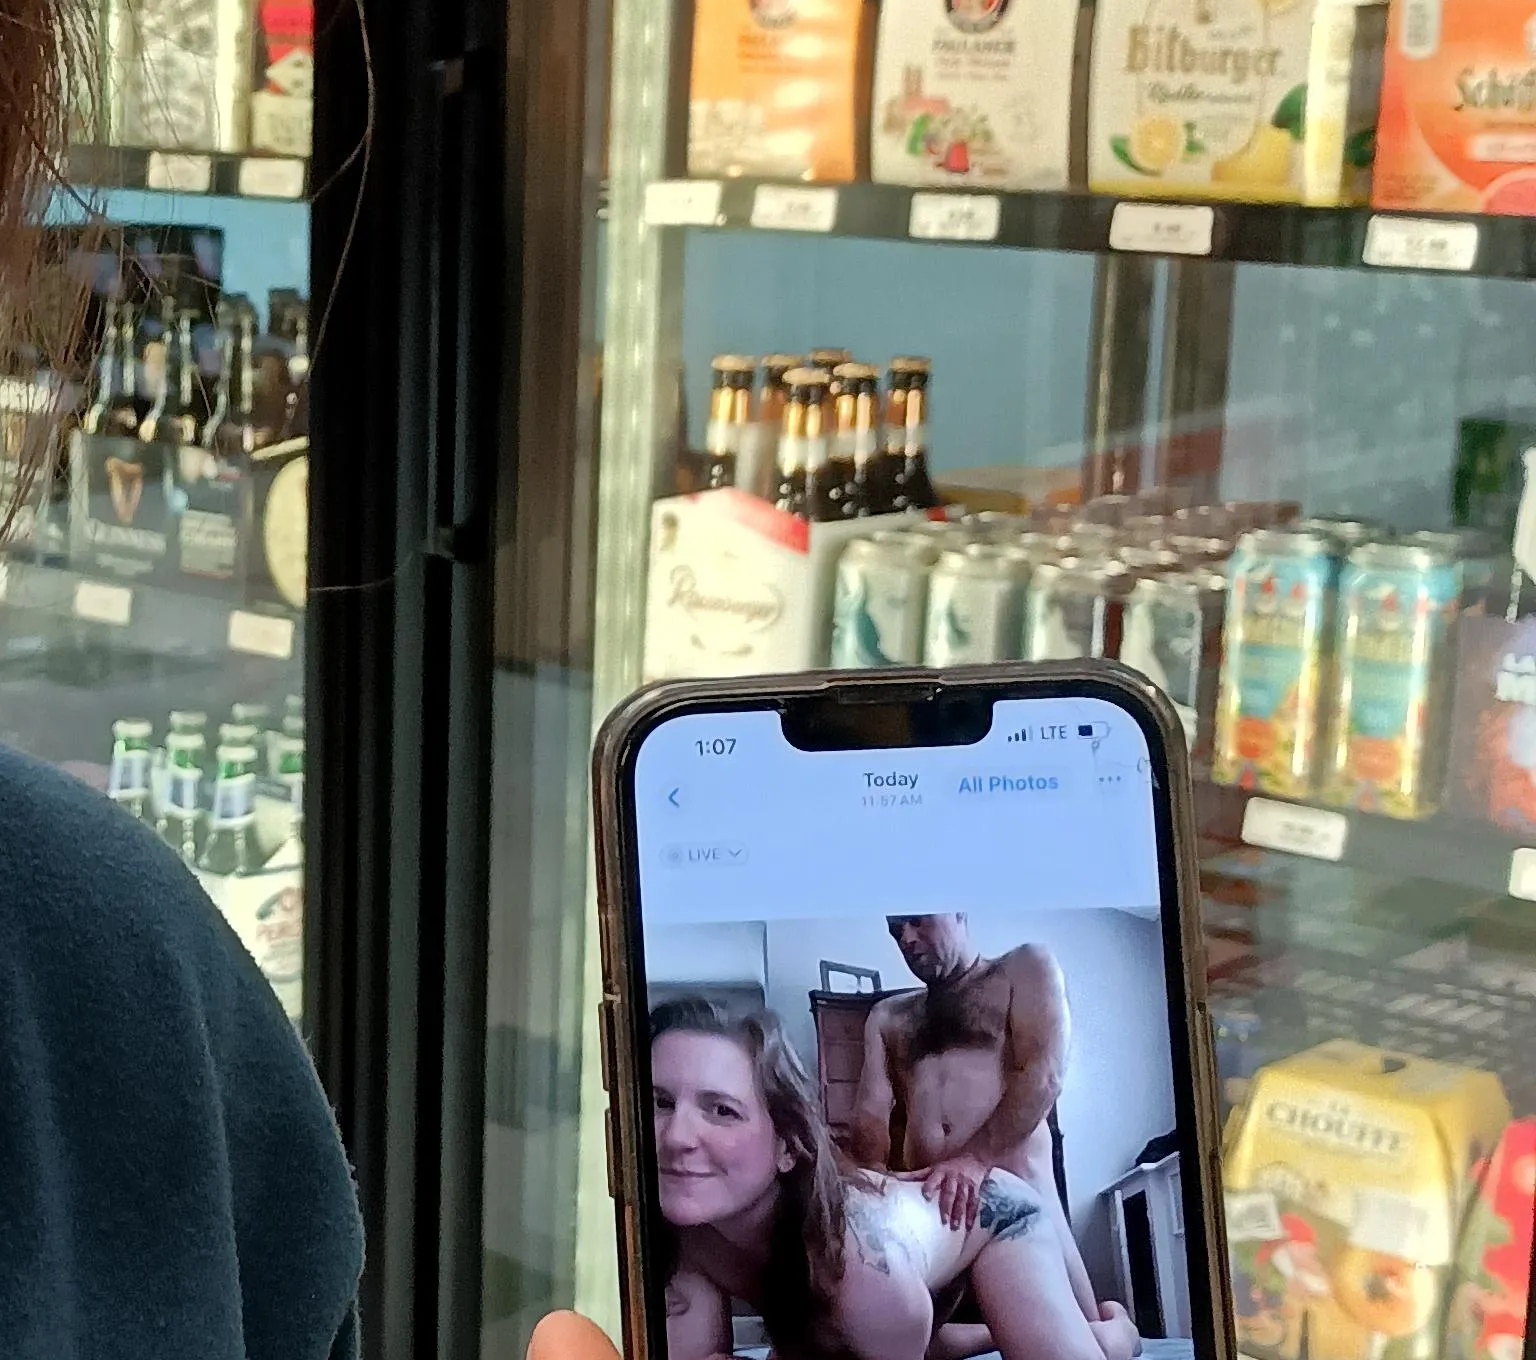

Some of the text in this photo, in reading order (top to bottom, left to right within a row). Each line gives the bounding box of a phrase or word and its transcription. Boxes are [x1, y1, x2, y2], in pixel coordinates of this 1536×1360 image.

[1041, 723, 1068, 741] LTE
[695, 738, 737, 757] 1:07
[864, 771, 919, 791] Today
[959, 774, 1059, 793] All Photos
[688, 847, 720, 862] LIVE
